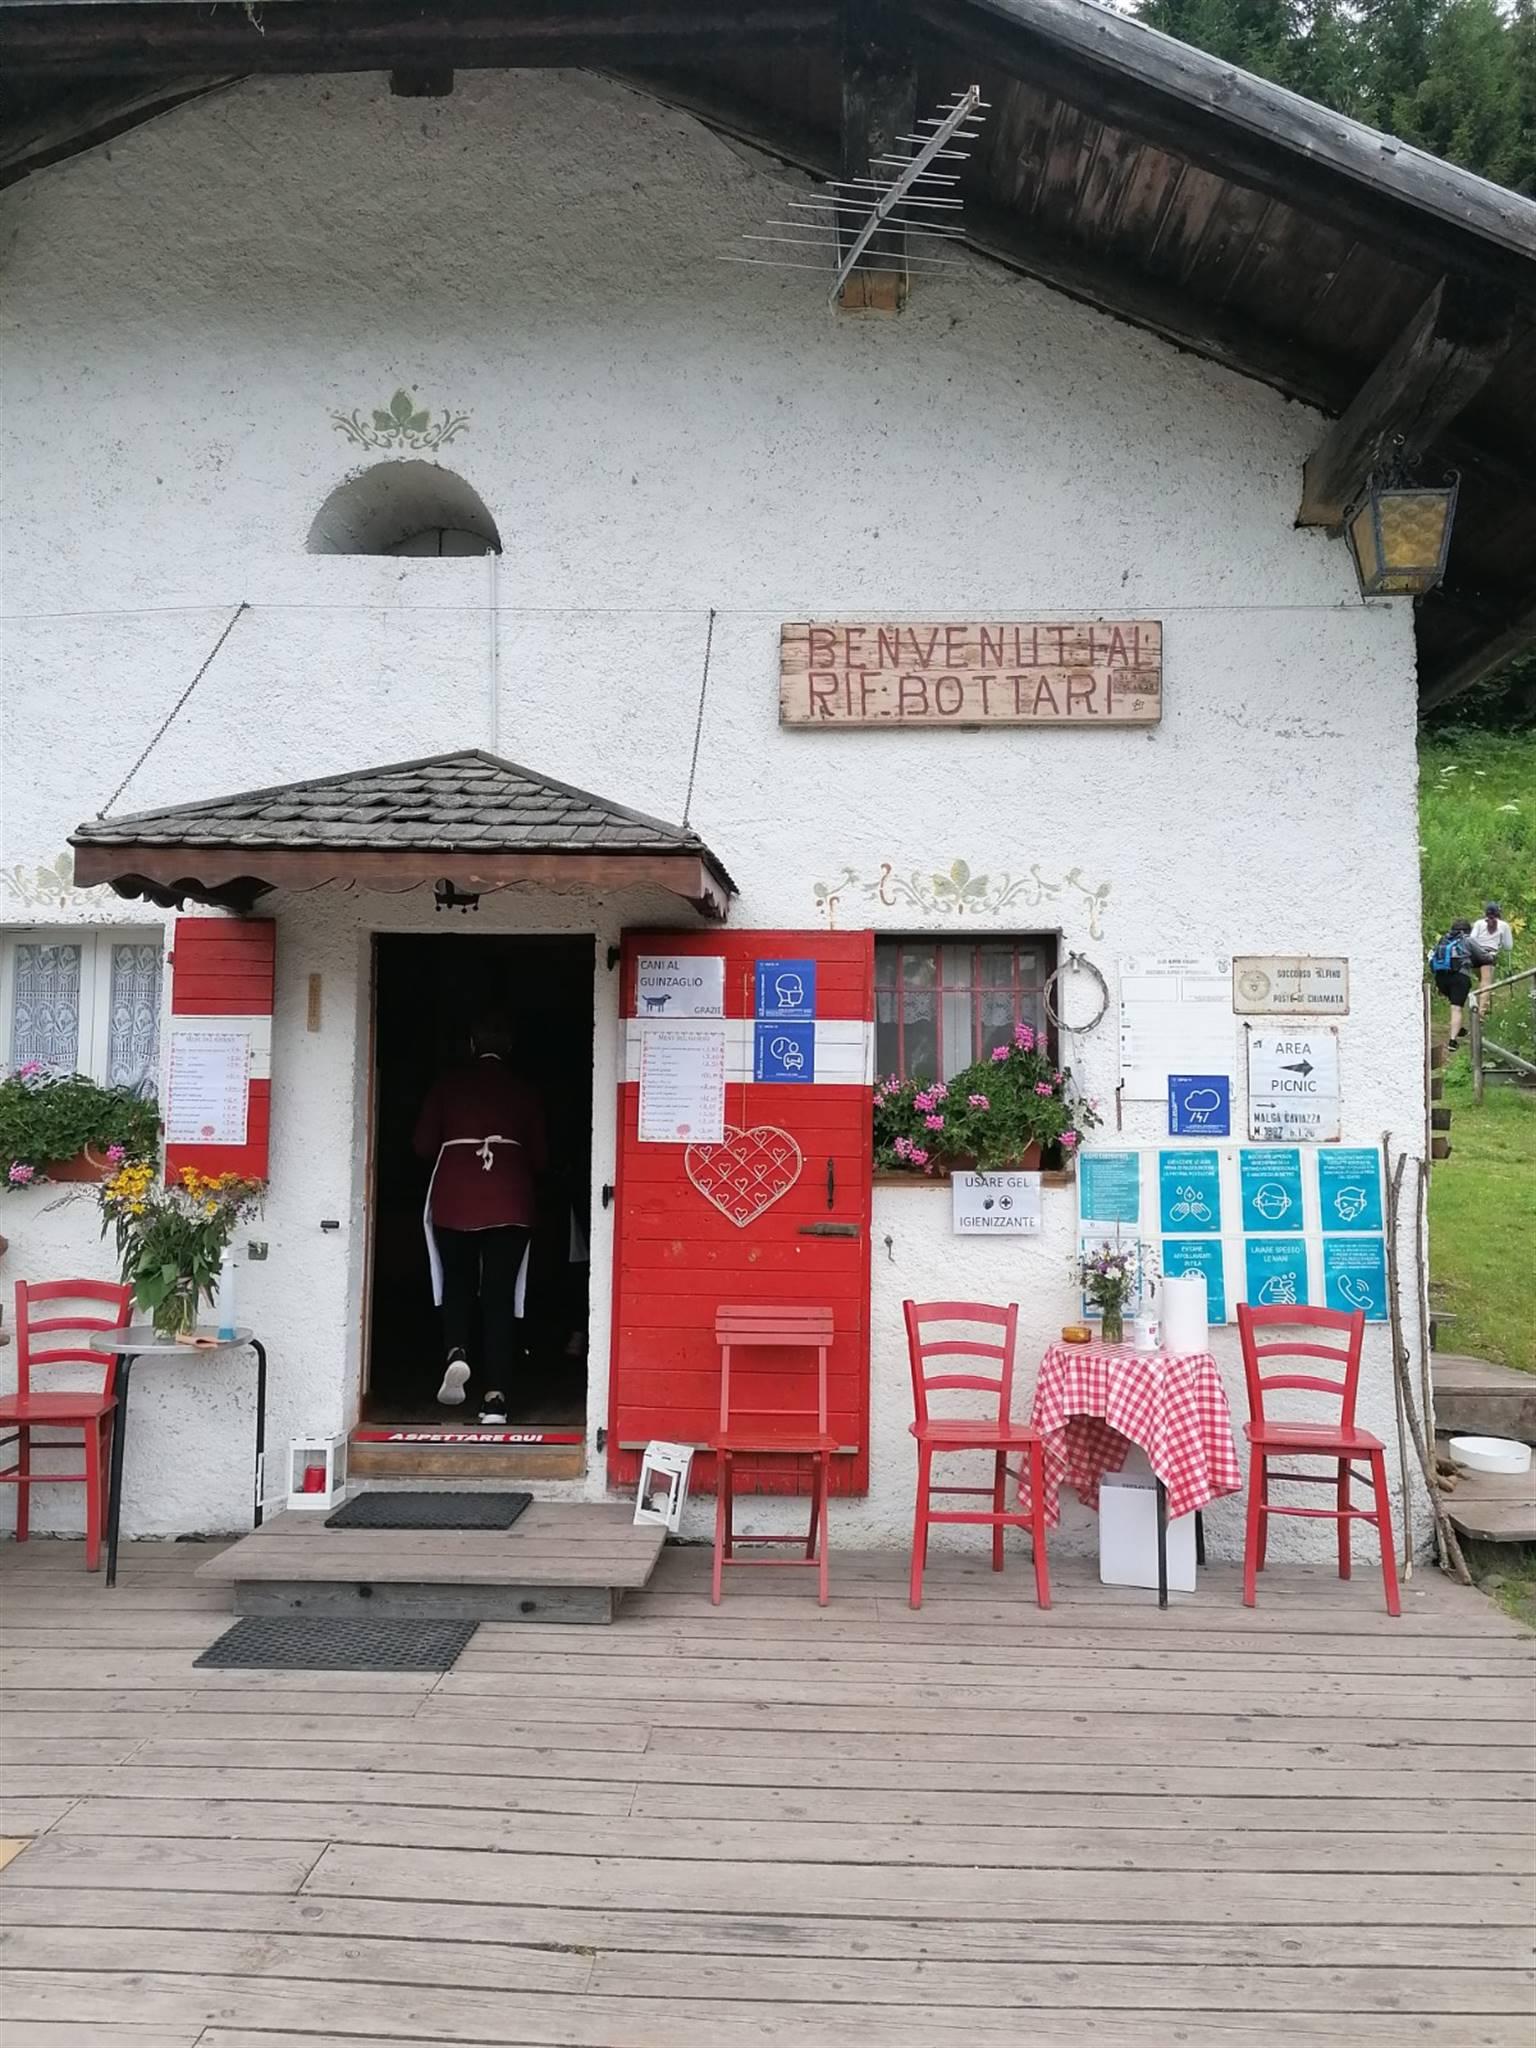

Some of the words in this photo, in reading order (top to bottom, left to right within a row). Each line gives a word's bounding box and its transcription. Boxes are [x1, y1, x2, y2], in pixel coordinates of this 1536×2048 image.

[808, 626, 1096, 669] BENVENUTI
[1107, 625, 1153, 668] AL
[640, 960, 665, 970] CANI
[666, 960, 679, 970] AL
[640, 977, 703, 987] GUINZAGLIO
[1275, 1042, 1311, 1055] AREA
[1271, 1079, 1317, 1092] PICNIC
[1254, 1112, 1281, 1123] MALGA
[965, 1177, 1003, 1187] USARE
[1007, 1177, 1029, 1188] GEL
[960, 1216, 1035, 1227] IGIENIZZANTE
[388, 1433, 506, 1441] ASPETTARE
[509, 1434, 544, 1442] QUI
